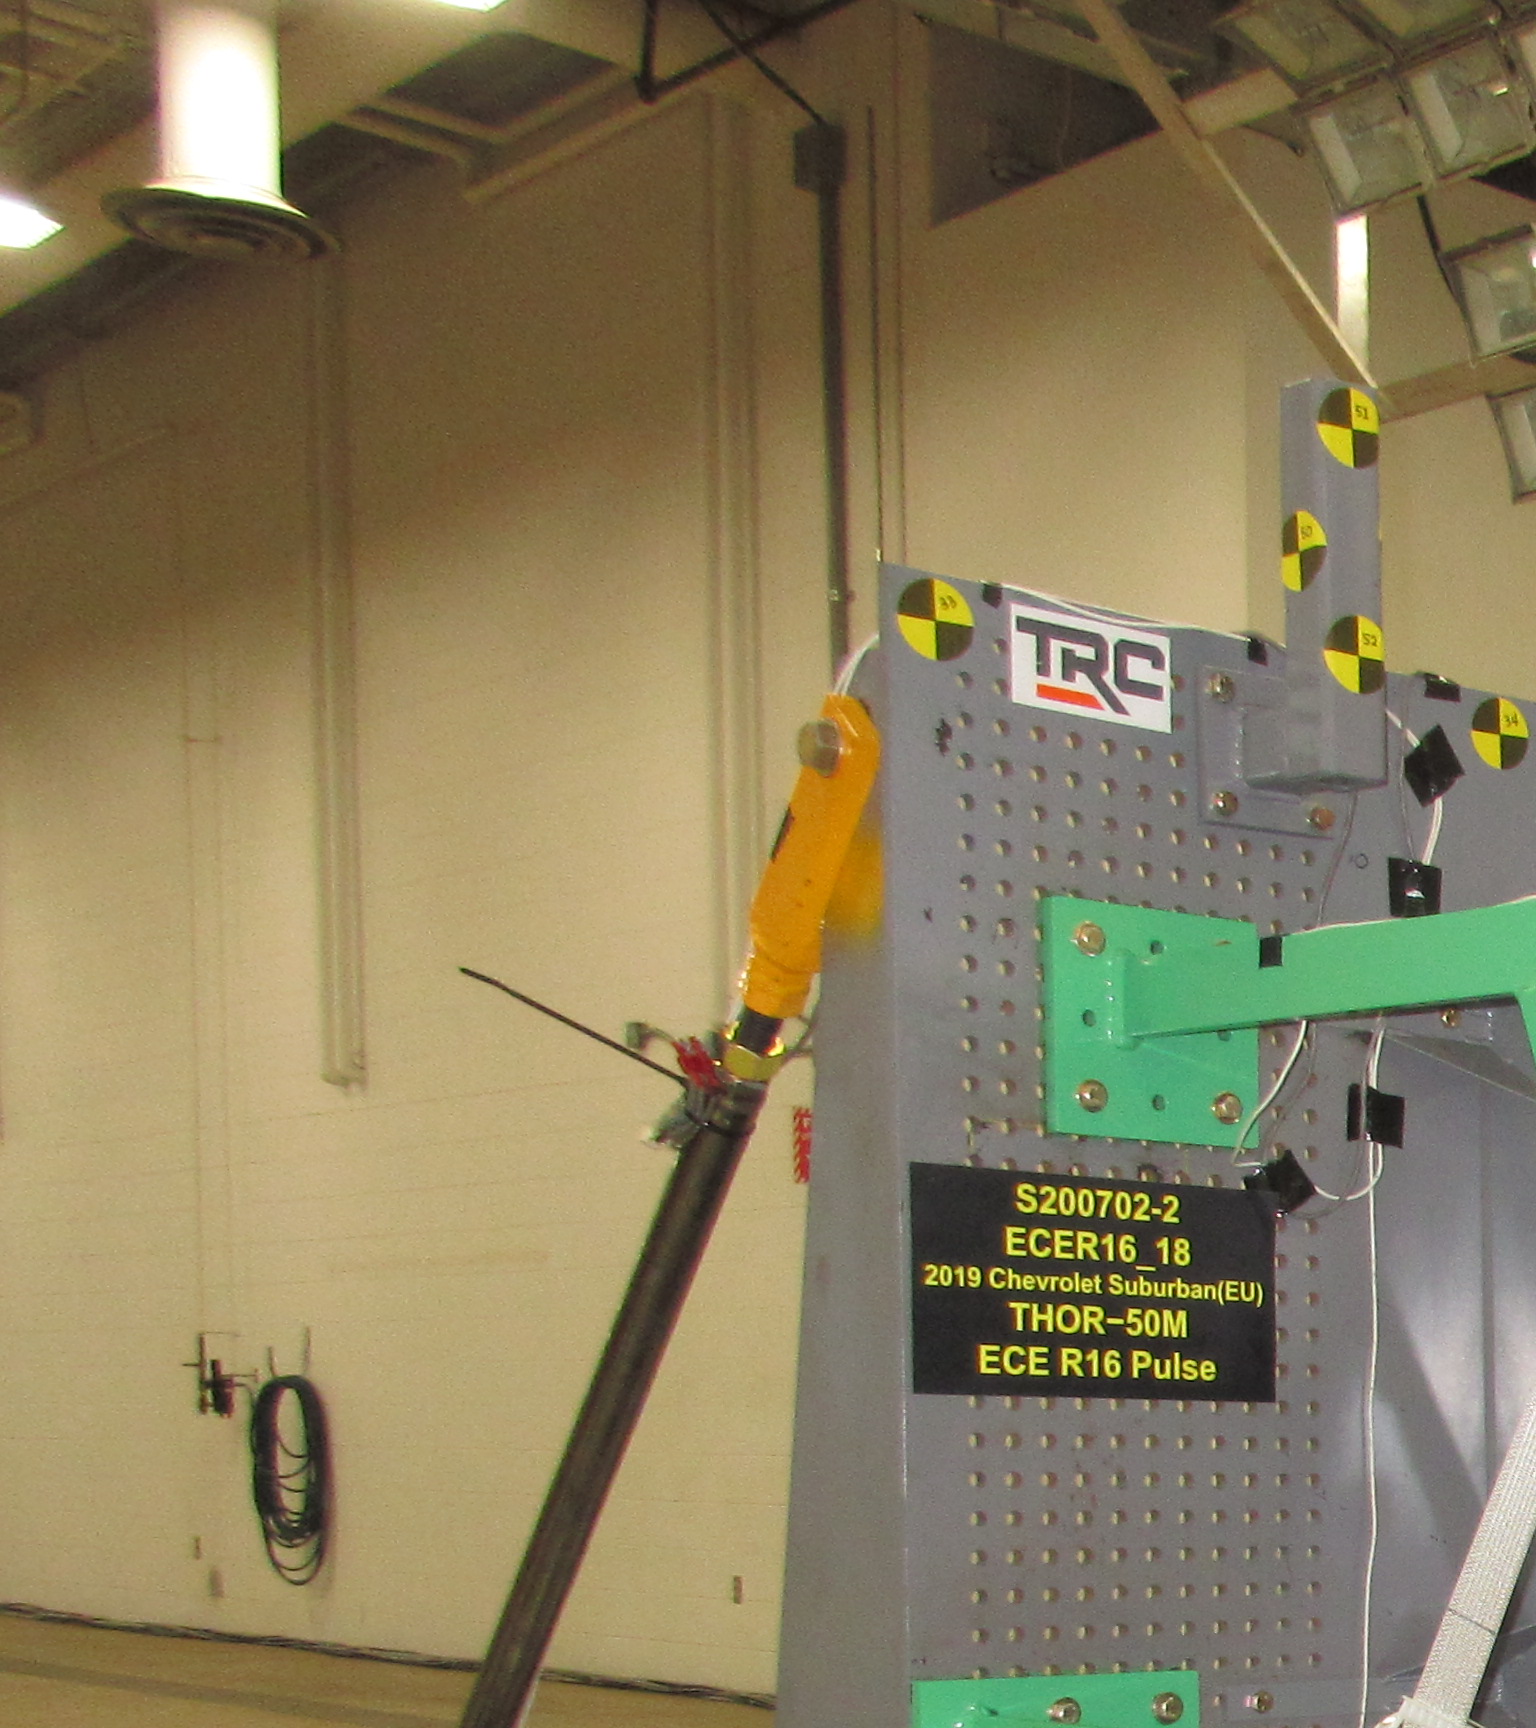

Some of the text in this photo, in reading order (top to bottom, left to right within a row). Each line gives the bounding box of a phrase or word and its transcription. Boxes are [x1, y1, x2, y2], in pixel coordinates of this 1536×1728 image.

[1015, 615, 1166, 716] TRC
[1015, 1182, 1181, 1225] S200702-2
[1004, 1226, 1192, 1272] ECER16_18
[923, 1263, 1265, 1308] 2019 Chevrolet Suburban(EU)
[1008, 1302, 1189, 1339] THOR-50M
[977, 1344, 1219, 1382] ECE R16 Pulse
